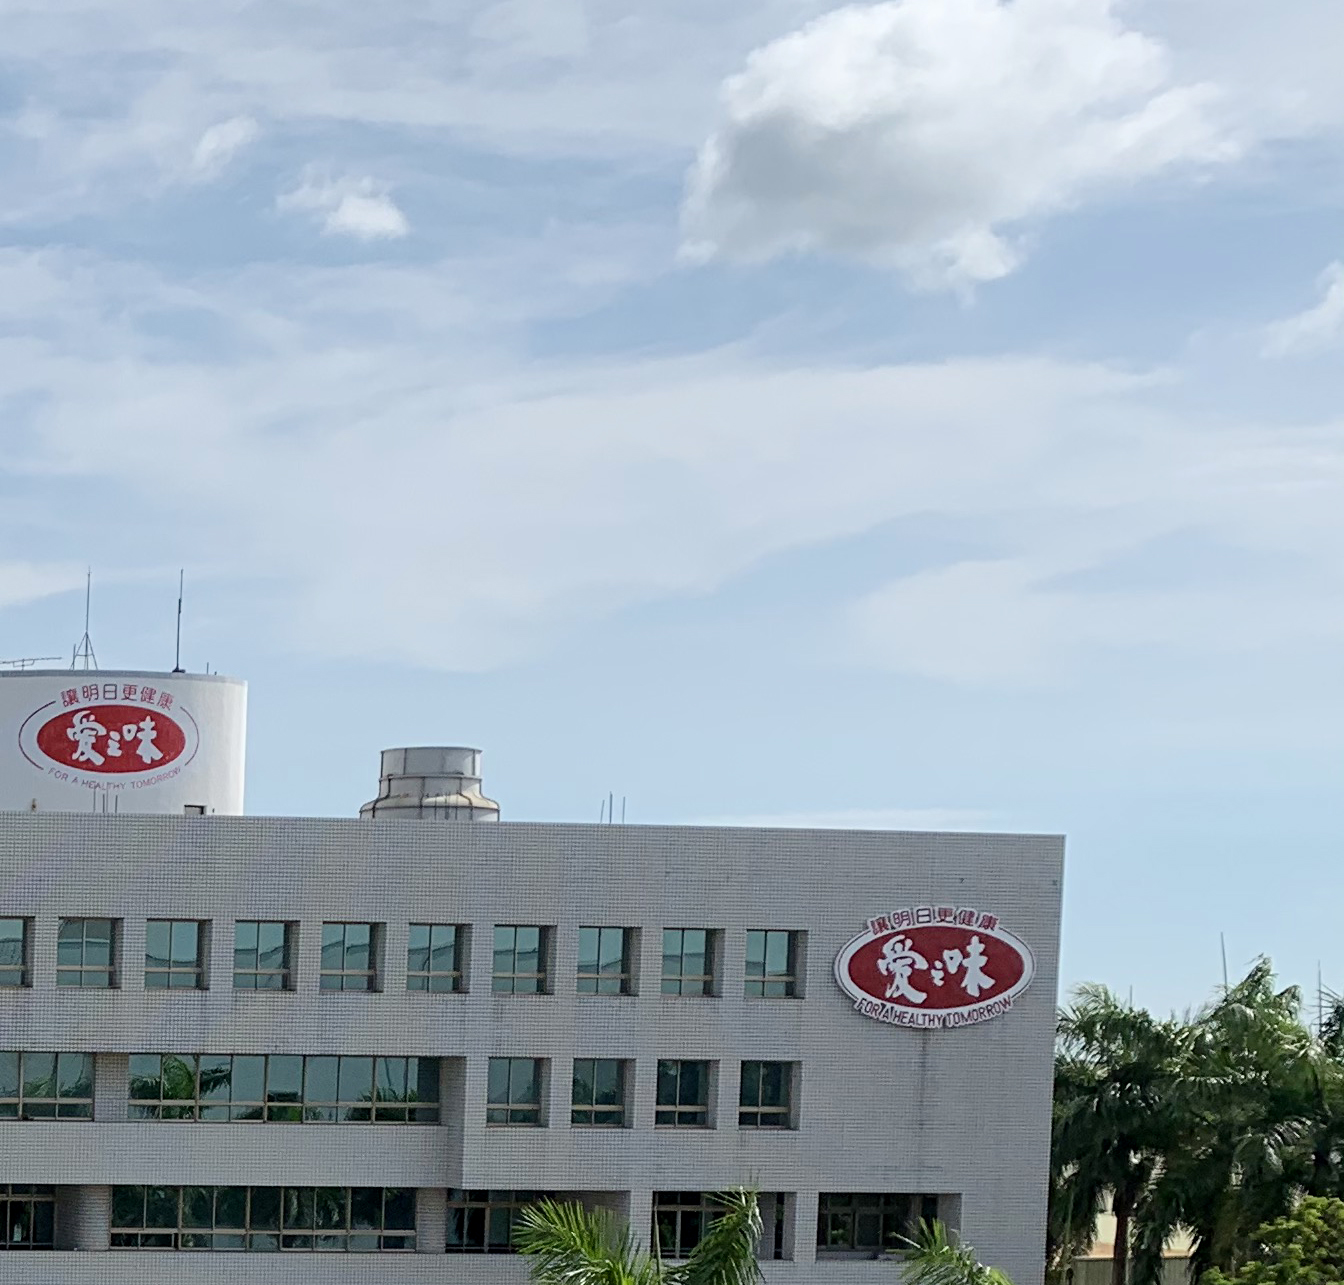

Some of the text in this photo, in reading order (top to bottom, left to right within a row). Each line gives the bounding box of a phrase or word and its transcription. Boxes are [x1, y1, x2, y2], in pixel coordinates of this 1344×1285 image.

[60, 684, 174, 711] 讓明日更健康
[66, 710, 164, 766] 愛之味
[48, 768, 69, 781] FOR
[81, 779, 126, 790] HEALTHY
[130, 766, 181, 789] TOMORROW
[870, 907, 999, 935] 讓明日更健康
[876, 934, 996, 1004] 愛之味
[857, 997, 1012, 1027] FOR A HEALTHY TOMORROW
